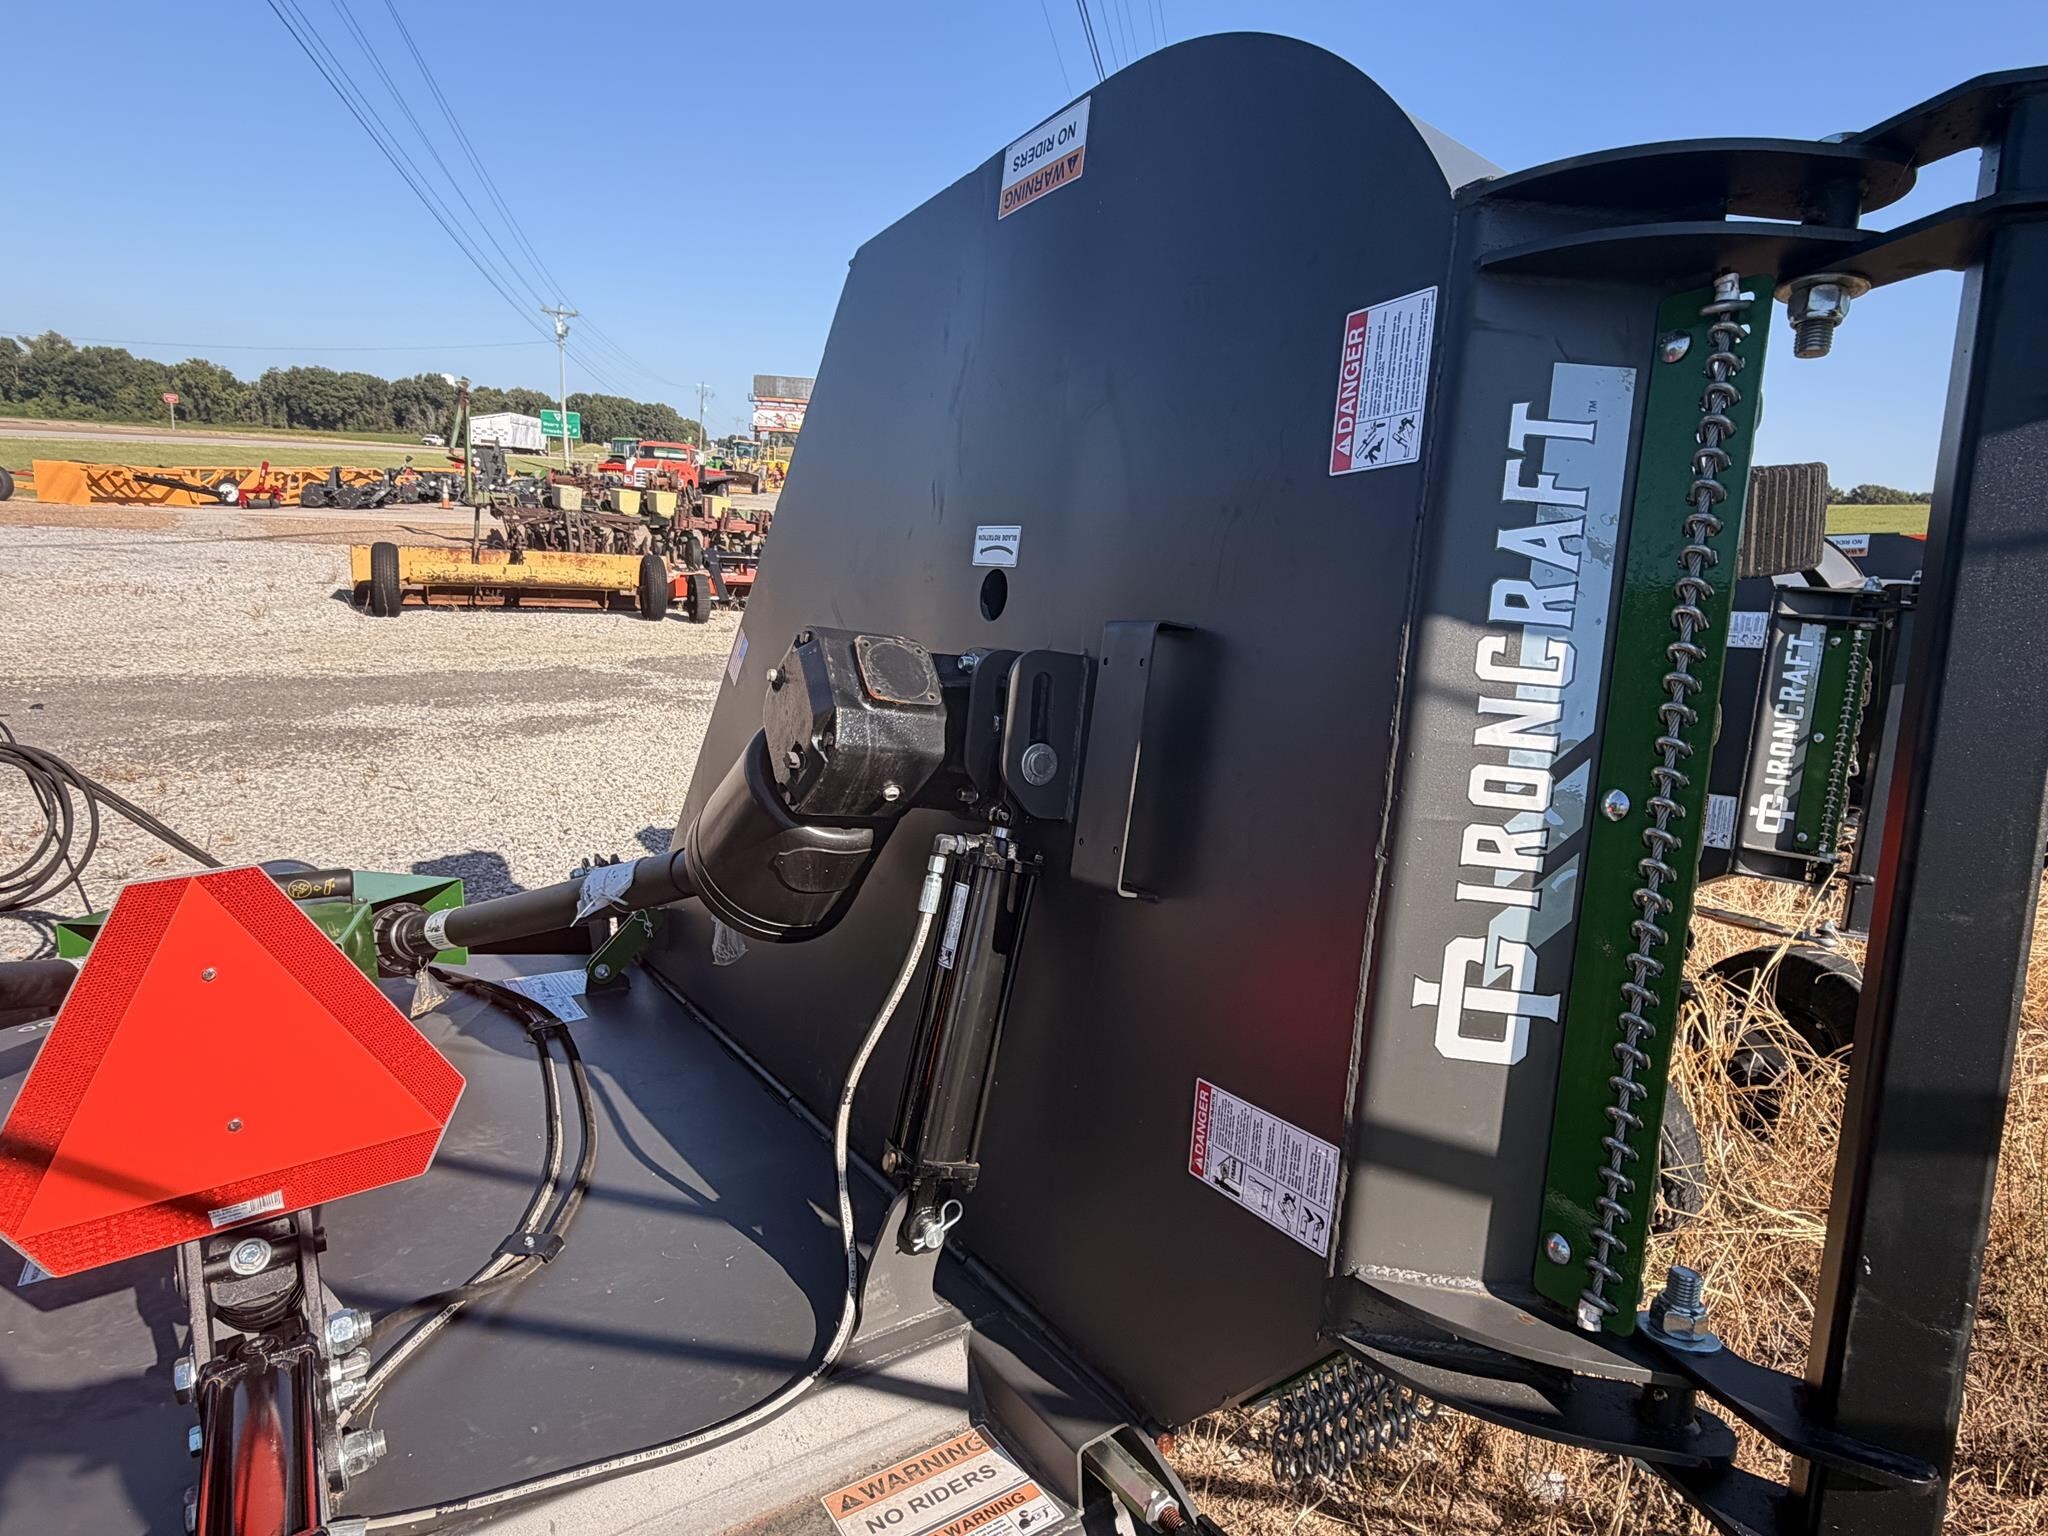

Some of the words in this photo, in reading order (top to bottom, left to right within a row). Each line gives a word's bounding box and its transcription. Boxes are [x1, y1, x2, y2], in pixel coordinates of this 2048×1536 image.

[1013, 134, 1055, 172] RIDERS
[1058, 121, 1077, 145] NO
[1004, 161, 1065, 209] WARNING
[1337, 326, 1365, 434] DANGER
[1456, 401, 1598, 909] IRONCRAFT
[1765, 633, 1814, 788] IRONCRAFT
[1194, 1089, 1210, 1155] DANGER
[859, 1436, 987, 1499] WARNING
[865, 1508, 904, 1535] NO
[908, 1464, 997, 1514] RIDERS
[944, 1492, 1027, 1536] WARNING
